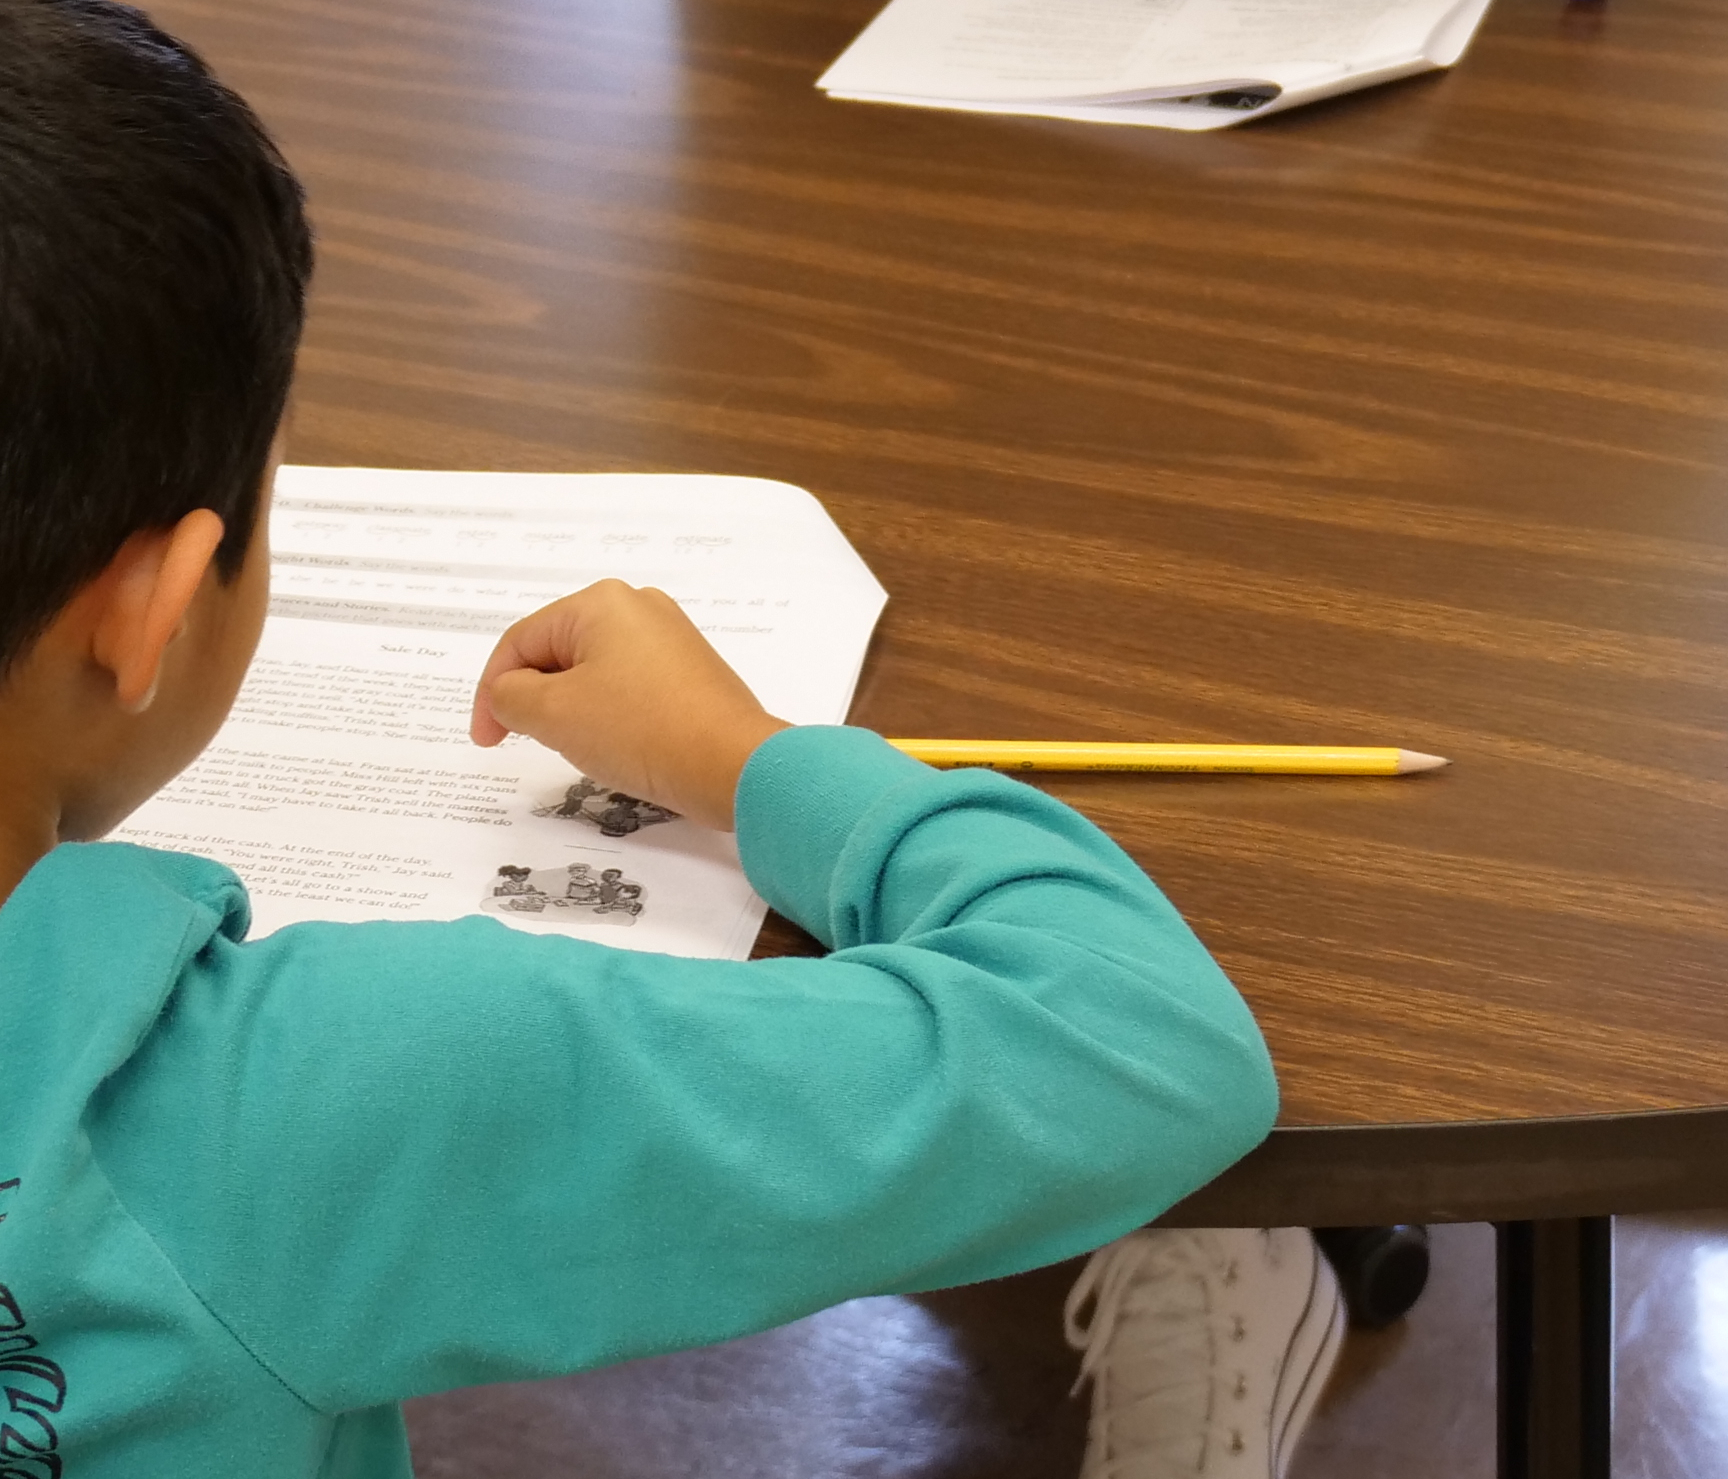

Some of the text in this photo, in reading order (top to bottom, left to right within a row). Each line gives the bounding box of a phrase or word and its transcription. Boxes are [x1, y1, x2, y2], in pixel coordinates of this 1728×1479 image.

[377, 644, 448, 661] Sale Day
[492, 818, 513, 827] do
